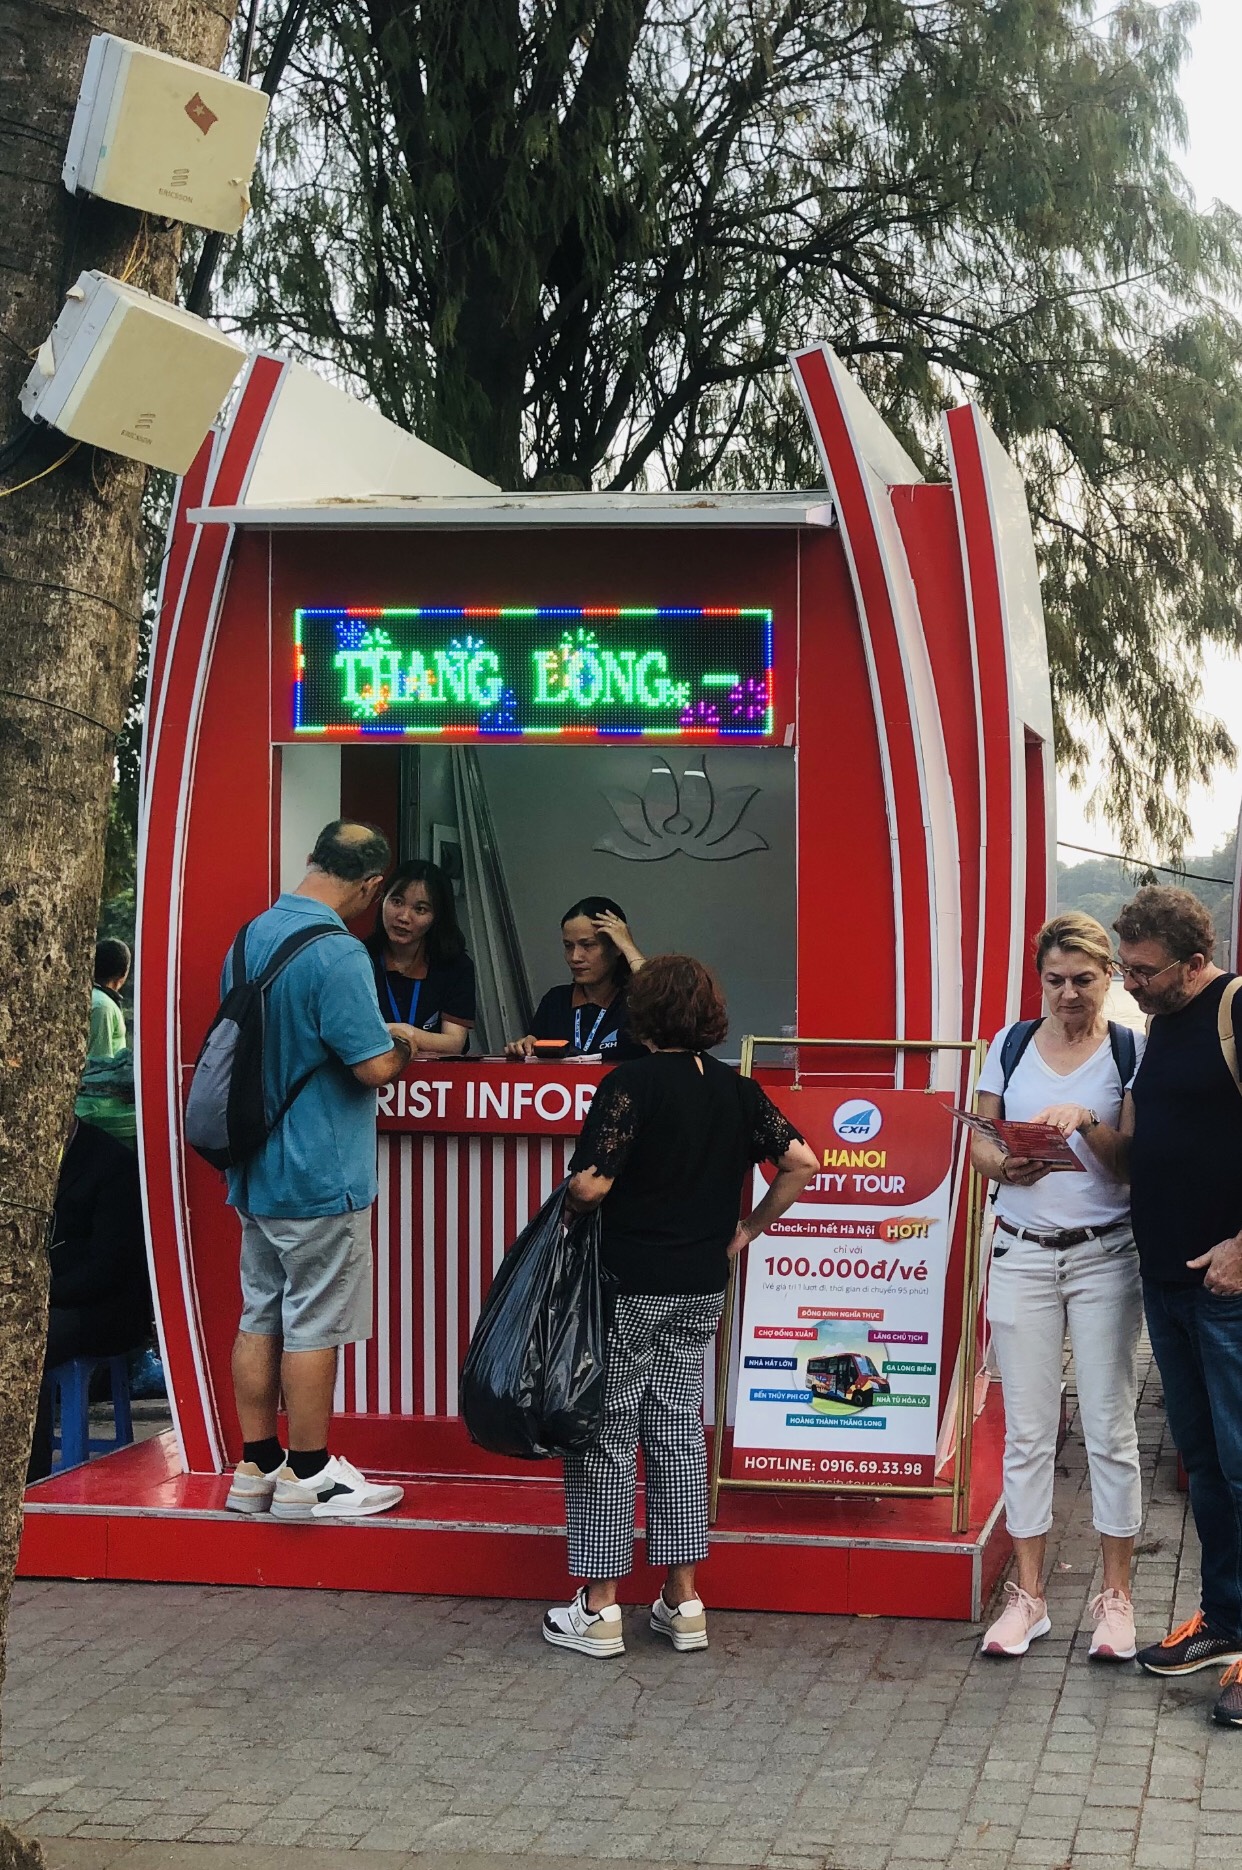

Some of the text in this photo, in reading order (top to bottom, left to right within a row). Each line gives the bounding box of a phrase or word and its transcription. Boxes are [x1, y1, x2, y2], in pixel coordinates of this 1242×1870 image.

[599, 1041, 618, 1050] CXH
[838, 1125, 870, 1135] CXH
[823, 1149, 887, 1169] HANOI
[852, 1174, 906, 1194] TOUR
[770, 1222, 875, 1237] Check-in hết Hà Nội
[886, 1223, 928, 1239] HOT!
[833, 1244, 863, 1254] chỉ với
[765, 1256, 928, 1282] 100.000đ/vé
[897, 1286, 908, 1294] 95
[758, 1329, 774, 1338] CHỢ
[744, 1456, 923, 1476] HOTLINE: 0916.69.33.98
